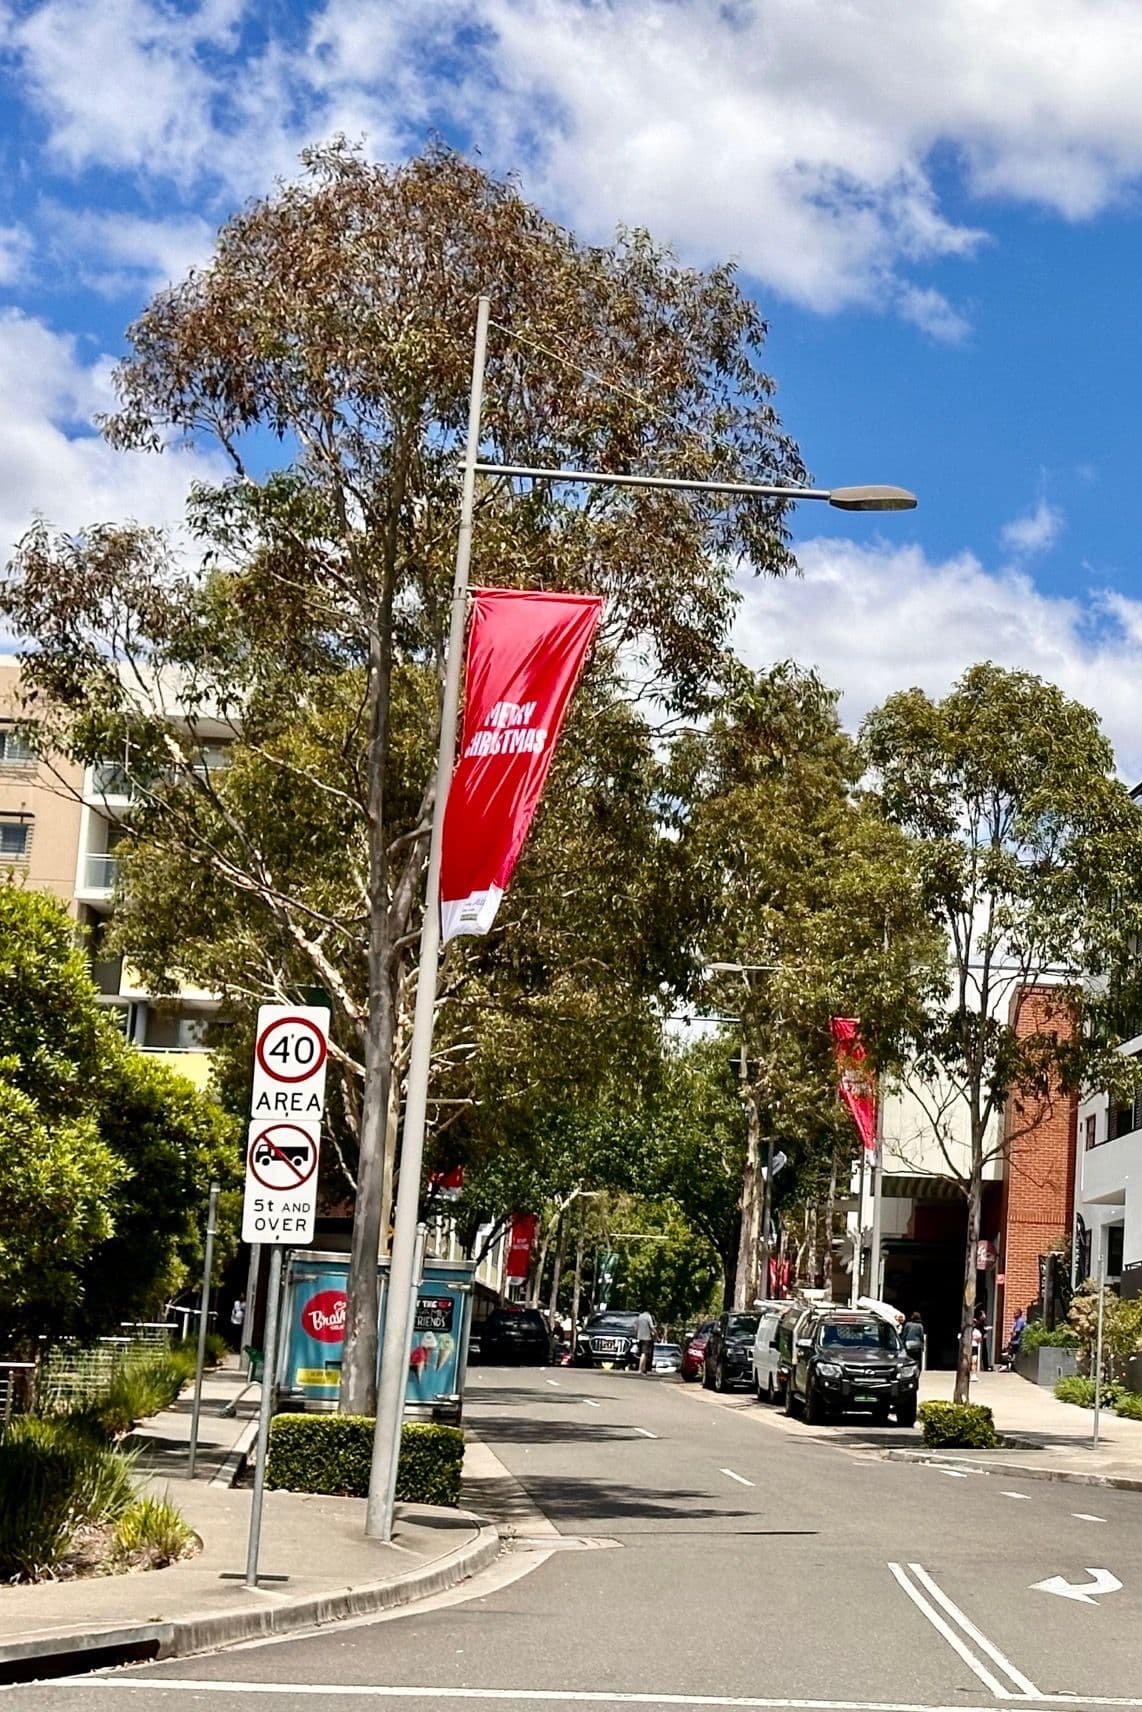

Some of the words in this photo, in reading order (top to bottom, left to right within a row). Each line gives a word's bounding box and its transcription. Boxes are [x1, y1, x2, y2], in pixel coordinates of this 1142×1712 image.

[268, 1035, 314, 1064] 40
[256, 1091, 321, 1112] AREA
[254, 1199, 274, 1212] 5t
[281, 1202, 311, 1213] AND
[255, 1217, 306, 1231] OVER
[415, 1316, 446, 1328] RIENDS
